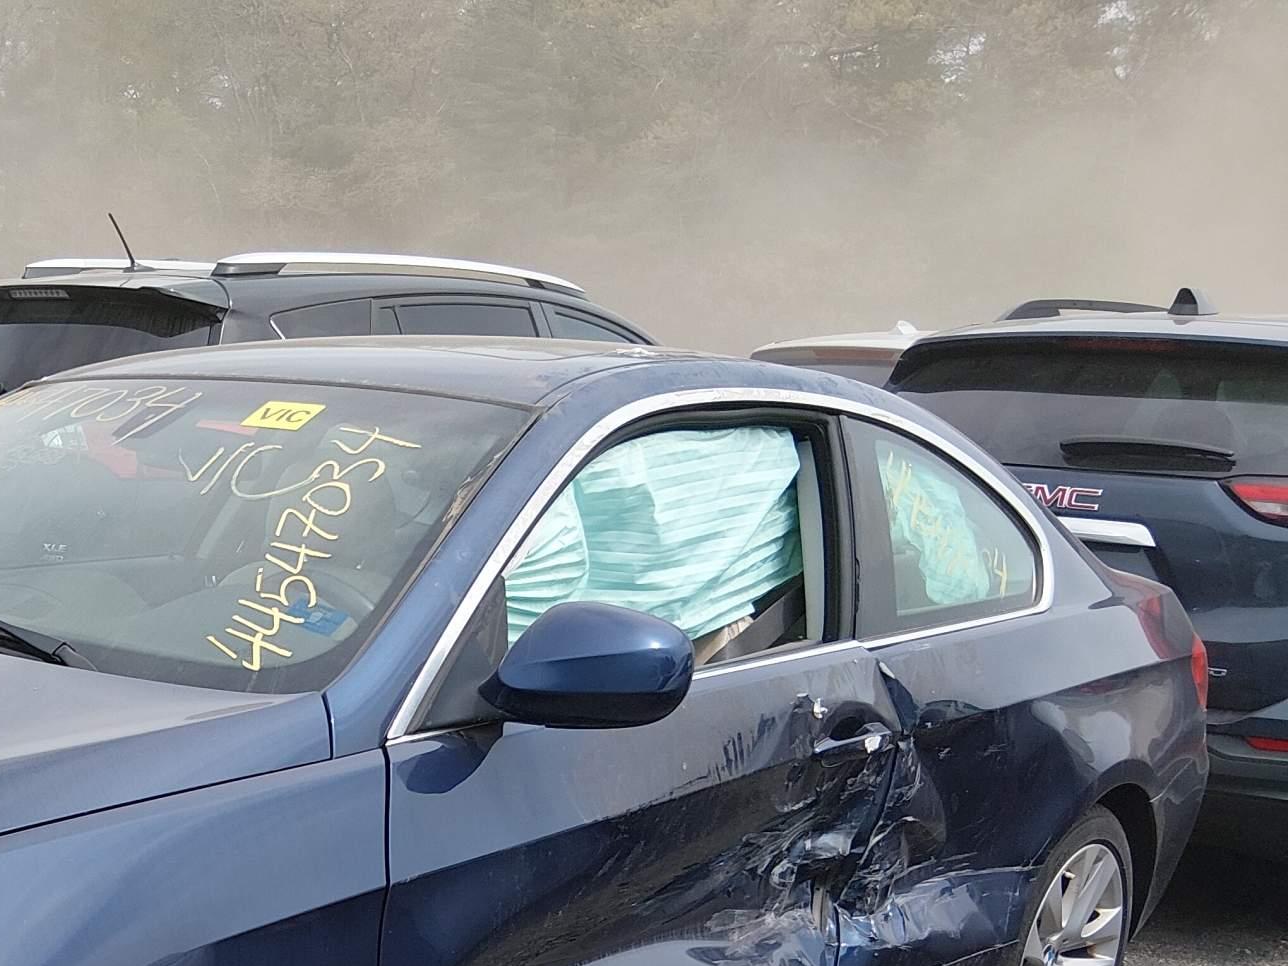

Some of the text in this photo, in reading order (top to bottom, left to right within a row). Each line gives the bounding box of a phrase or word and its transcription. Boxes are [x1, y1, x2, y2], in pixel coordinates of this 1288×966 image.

[261, 408, 311, 424] VIC
[178, 441, 315, 499] VIC
[1023, 483, 1103, 511] MC
[206, 426, 421, 671] 44547034
